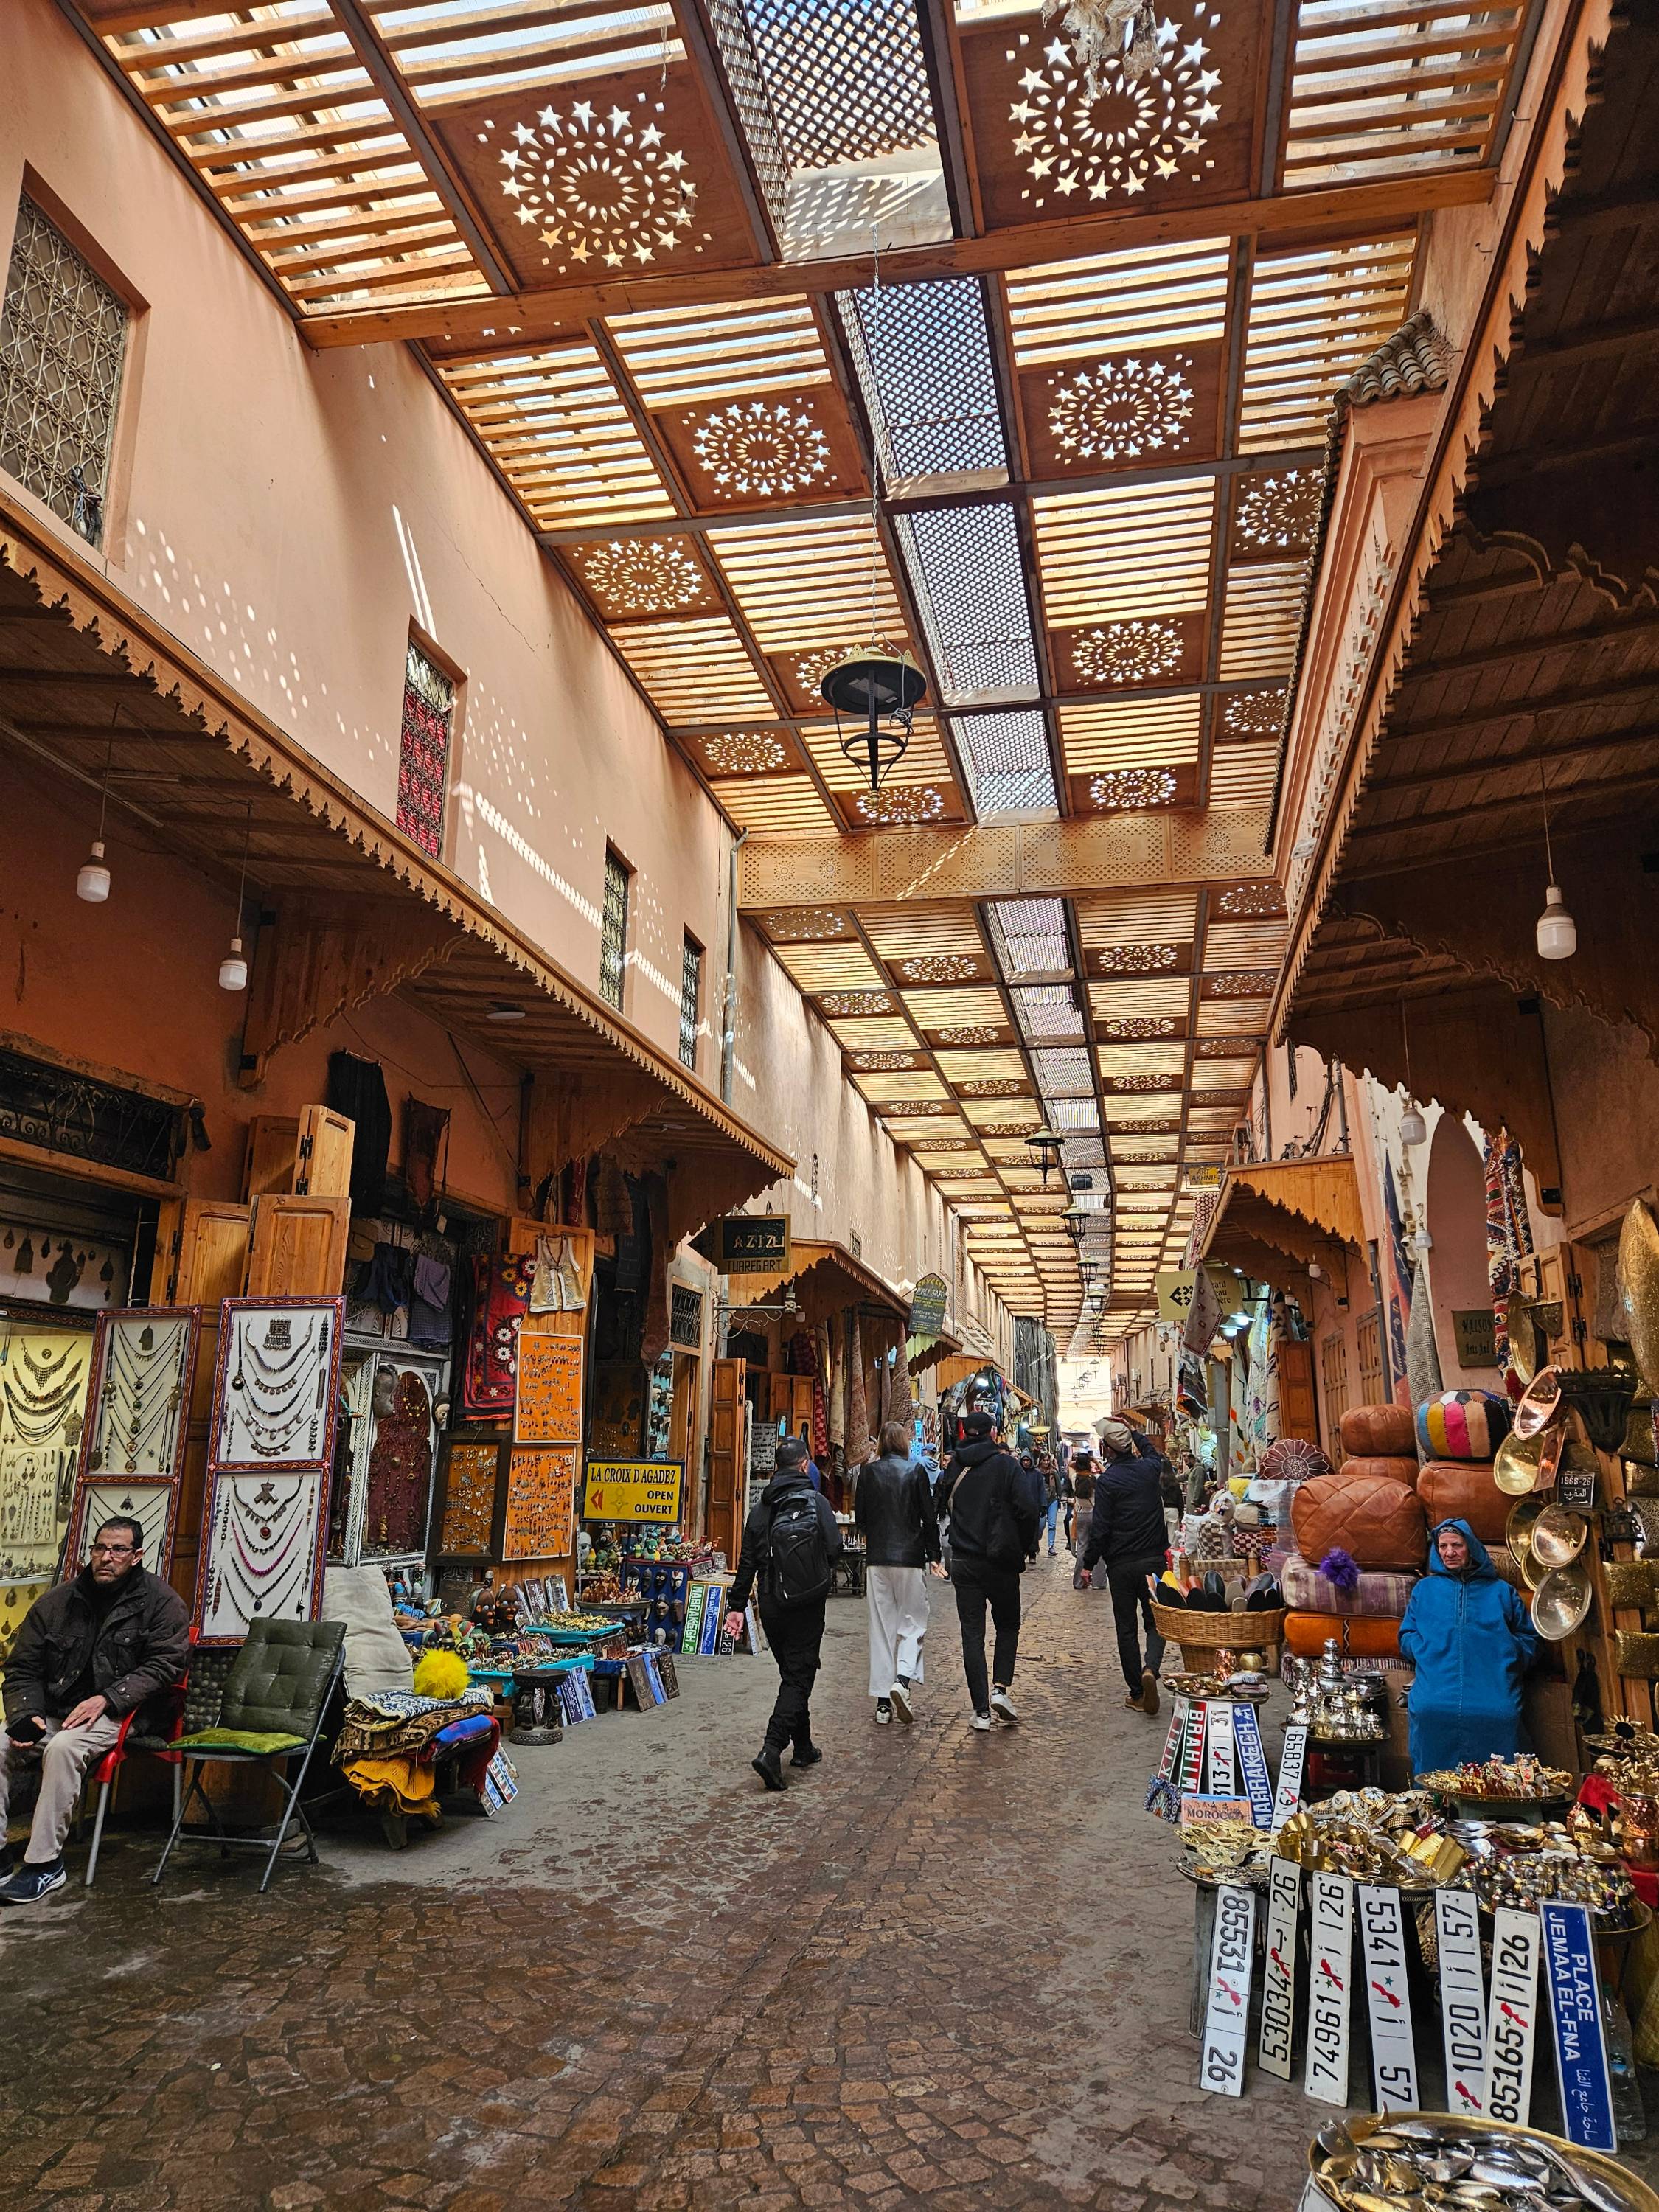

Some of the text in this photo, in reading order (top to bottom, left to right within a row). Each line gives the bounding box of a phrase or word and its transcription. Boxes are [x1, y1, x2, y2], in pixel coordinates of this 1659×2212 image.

[727, 1259, 782, 1272] TUAREG ART
[591, 1467, 676, 1484] LA CROIX D'AGADEZ
[647, 1491, 674, 1500] OPEN
[635, 1504, 672, 1514] OUVERT
[722, 1642, 732, 1652] 26
[1211, 1709, 1229, 1728] 31
[1181, 1709, 1204, 1790] BRAHIM
[1281, 1733, 1304, 1779] 65837
[1237, 1722, 1272, 1829] MARRAKECH
[1273, 1873, 1296, 1909] 26
[1319, 1882, 1344, 1918] 26
[1217, 1895, 1250, 1973] 85531
[1366, 1901, 1401, 1967] 5341
[1441, 1903, 1473, 1938] 57
[1500, 1934, 1531, 1972] 26
[1549, 1911, 1581, 2062] JEMAA EL-FNA
[1571, 1953, 1594, 2023] PLACE
[1262, 1972, 1291, 2062] 53034
[1313, 1994, 1342, 2082] 74961
[1449, 2003, 1484, 2072] 1020
[1207, 2045, 1238, 2082] 26
[1380, 2065, 1413, 2103] 57
[1489, 2025, 1525, 2124] 85165
[1571, 2069, 1598, 2140] ساحة جامع الفنا
